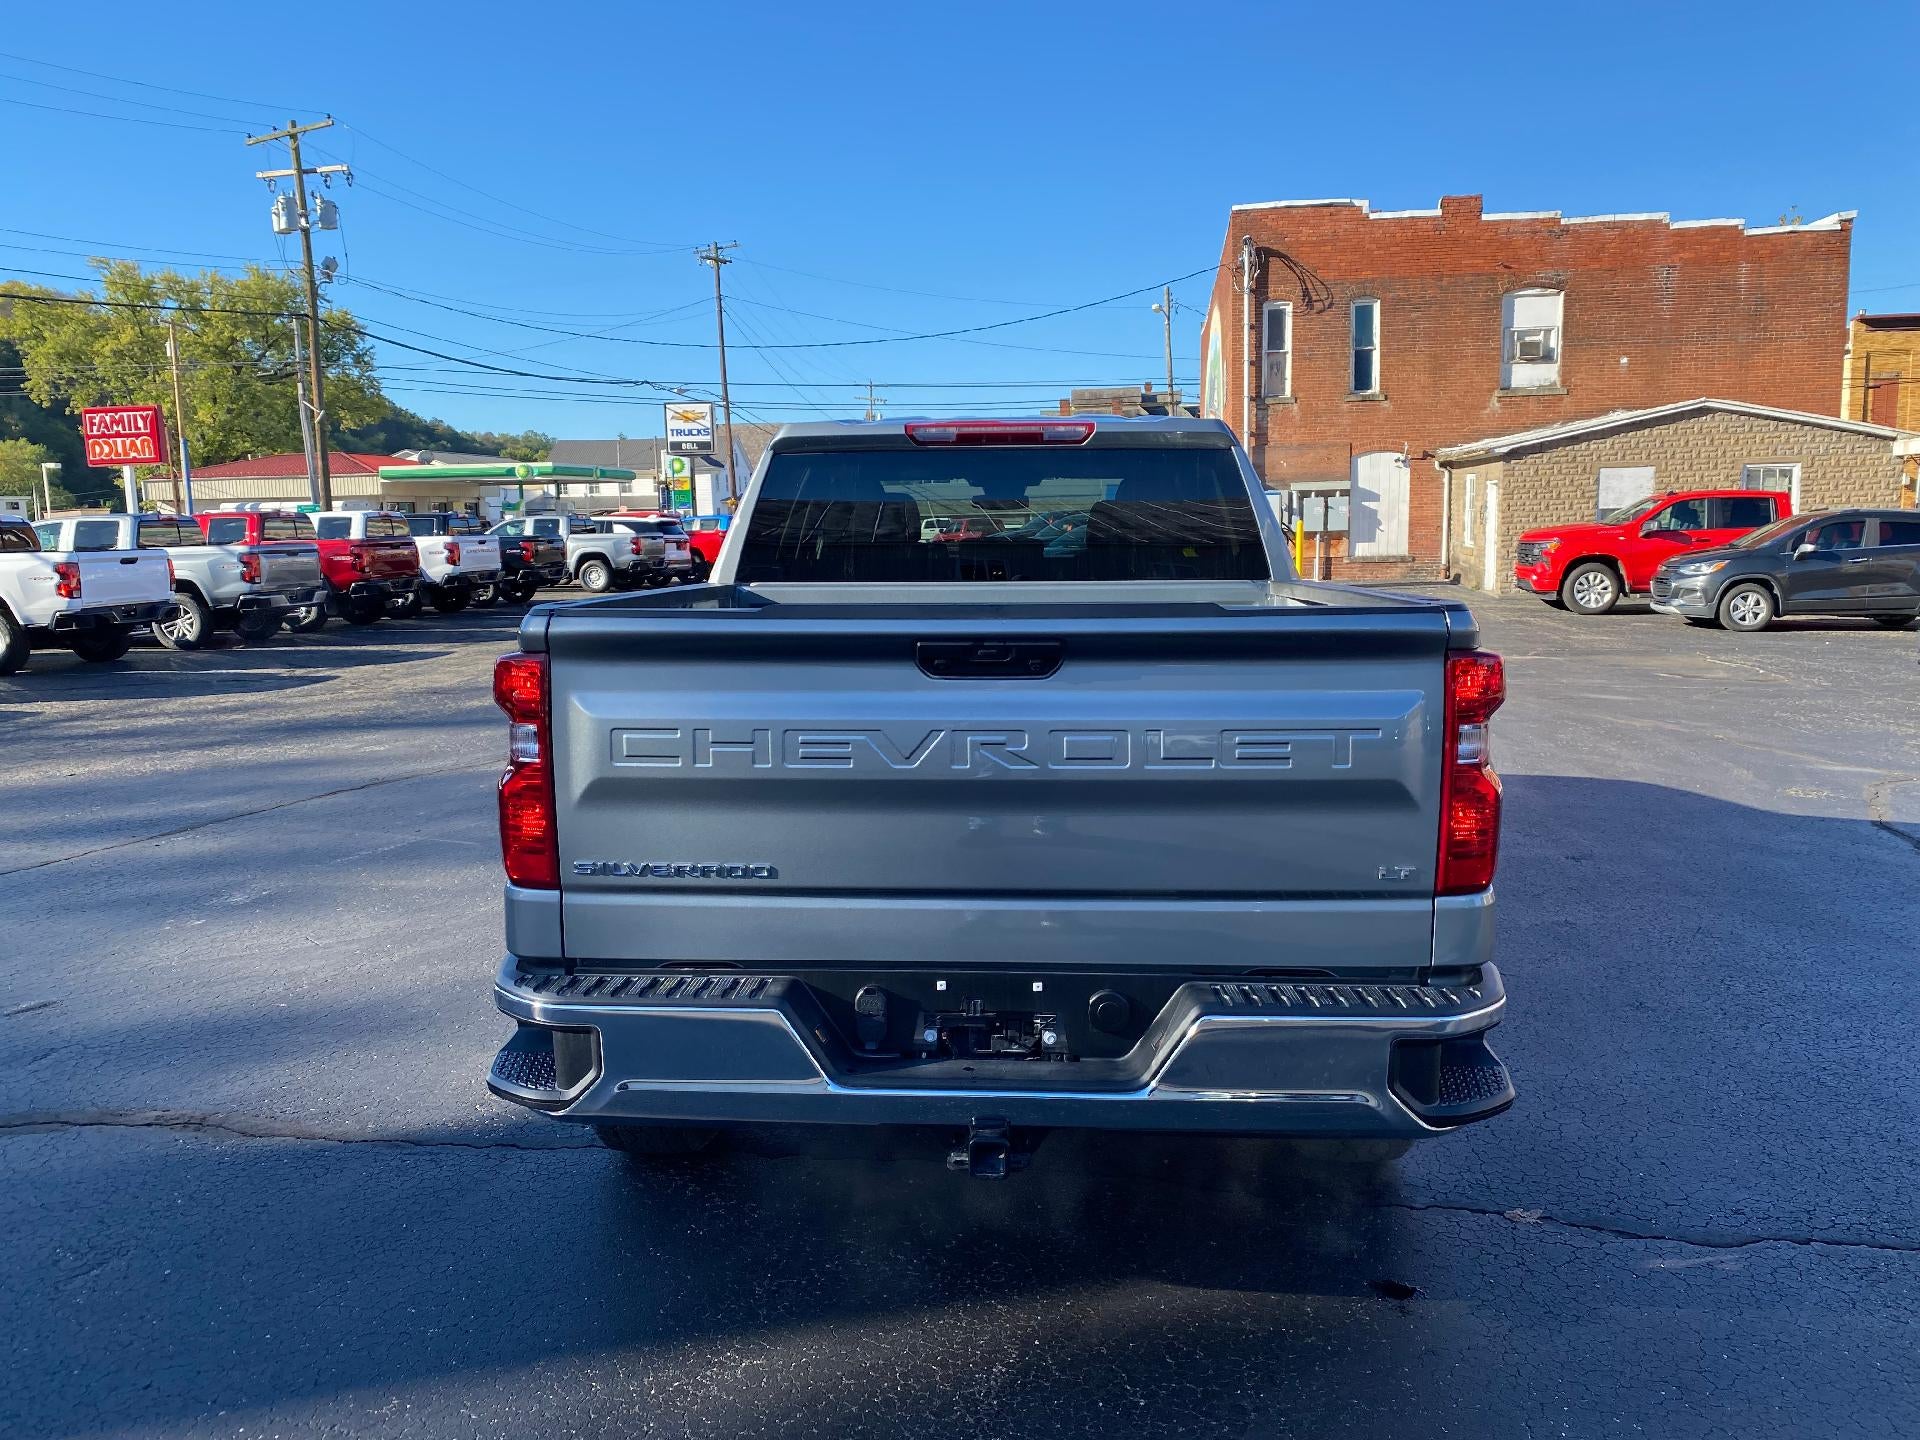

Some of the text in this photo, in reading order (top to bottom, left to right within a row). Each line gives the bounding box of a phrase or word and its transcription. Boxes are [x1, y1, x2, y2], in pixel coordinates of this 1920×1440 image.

[86, 411, 153, 434] FAMILY
[670, 428, 710, 437] TRUCKS
[88, 436, 156, 460] DOLLAR
[610, 728, 1382, 769] CHEVROLET
[573, 861, 777, 879] SILVERADO
[1377, 866, 1417, 880] LT
